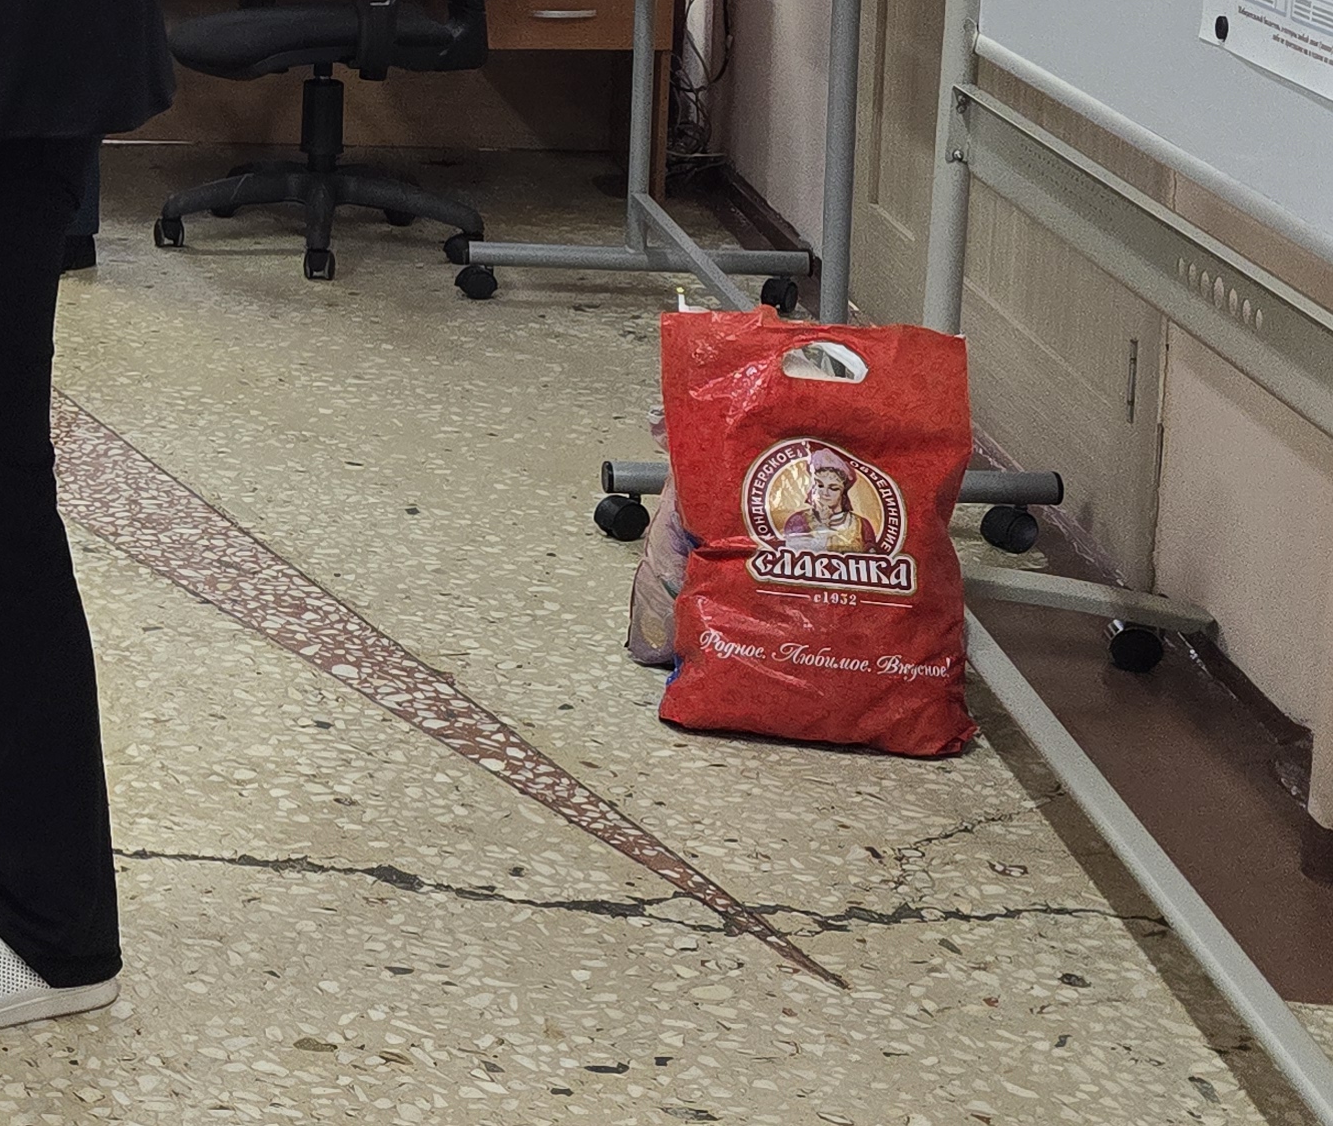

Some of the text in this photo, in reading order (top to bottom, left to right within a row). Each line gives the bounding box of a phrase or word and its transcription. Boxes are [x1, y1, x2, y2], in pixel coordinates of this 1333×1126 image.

[751, 448, 899, 552] КОНДИТЕРСКОЕ ОБЪЕДИНЕНИЕ
[755, 552, 908, 586] СЛАВЯНКА
[699, 629, 951, 682] Родное. Любимое. Вкусное!
